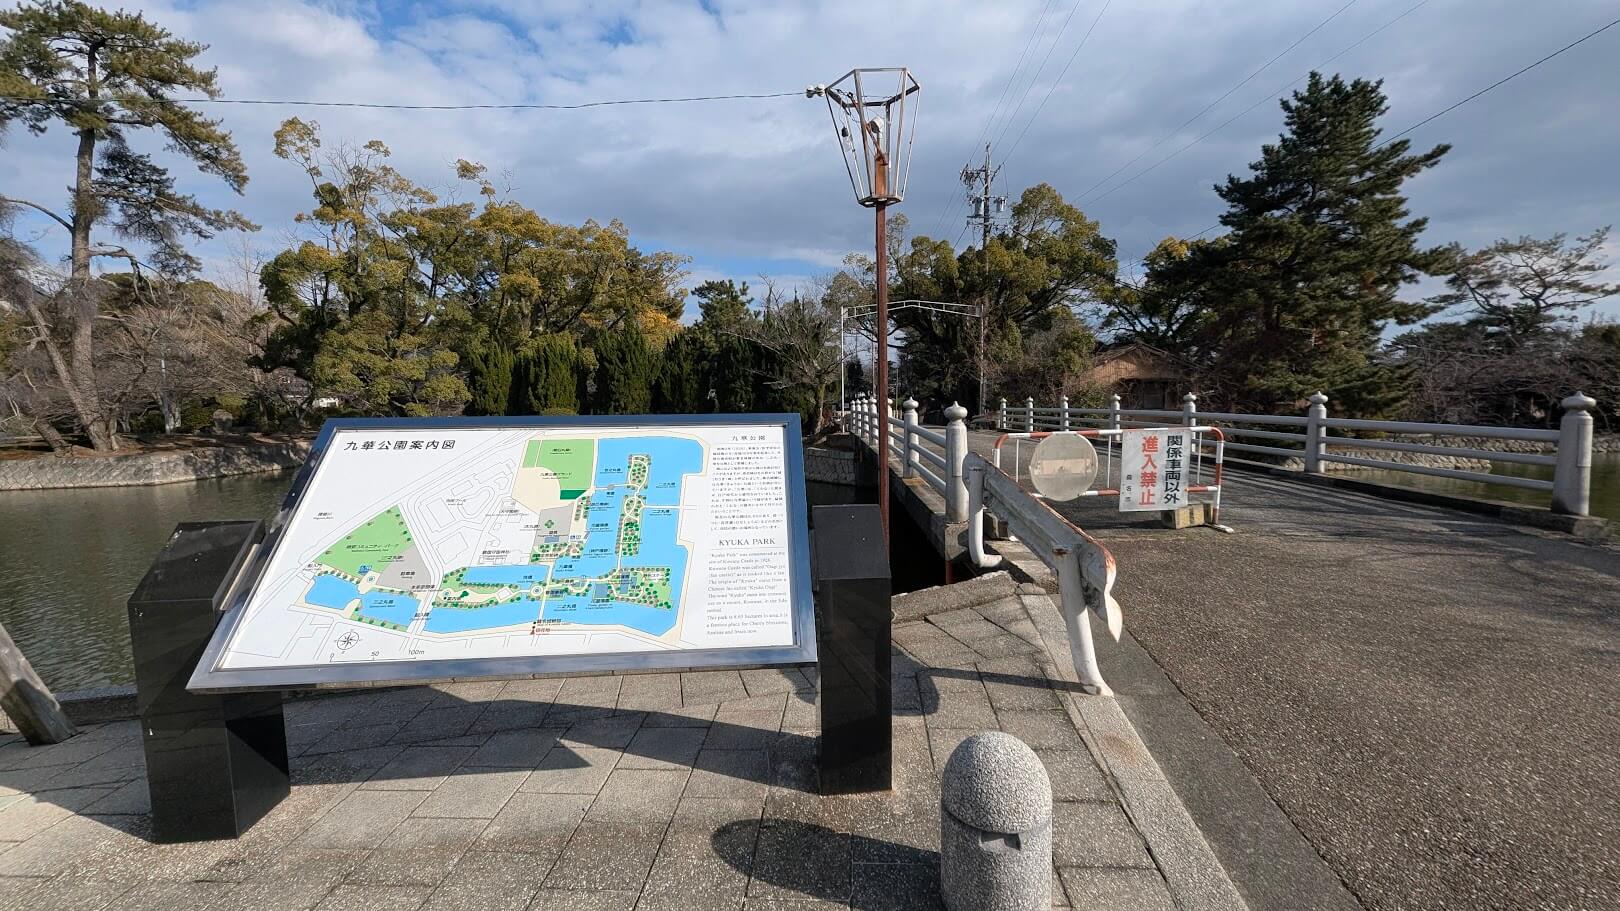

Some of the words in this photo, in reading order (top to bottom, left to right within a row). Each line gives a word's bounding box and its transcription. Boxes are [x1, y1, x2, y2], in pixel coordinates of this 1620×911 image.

[344, 440, 456, 450] 九華公園案内図
[1139, 435, 1159, 505] 進入禁止
[1164, 435, 1183, 504] 関係車両以外
